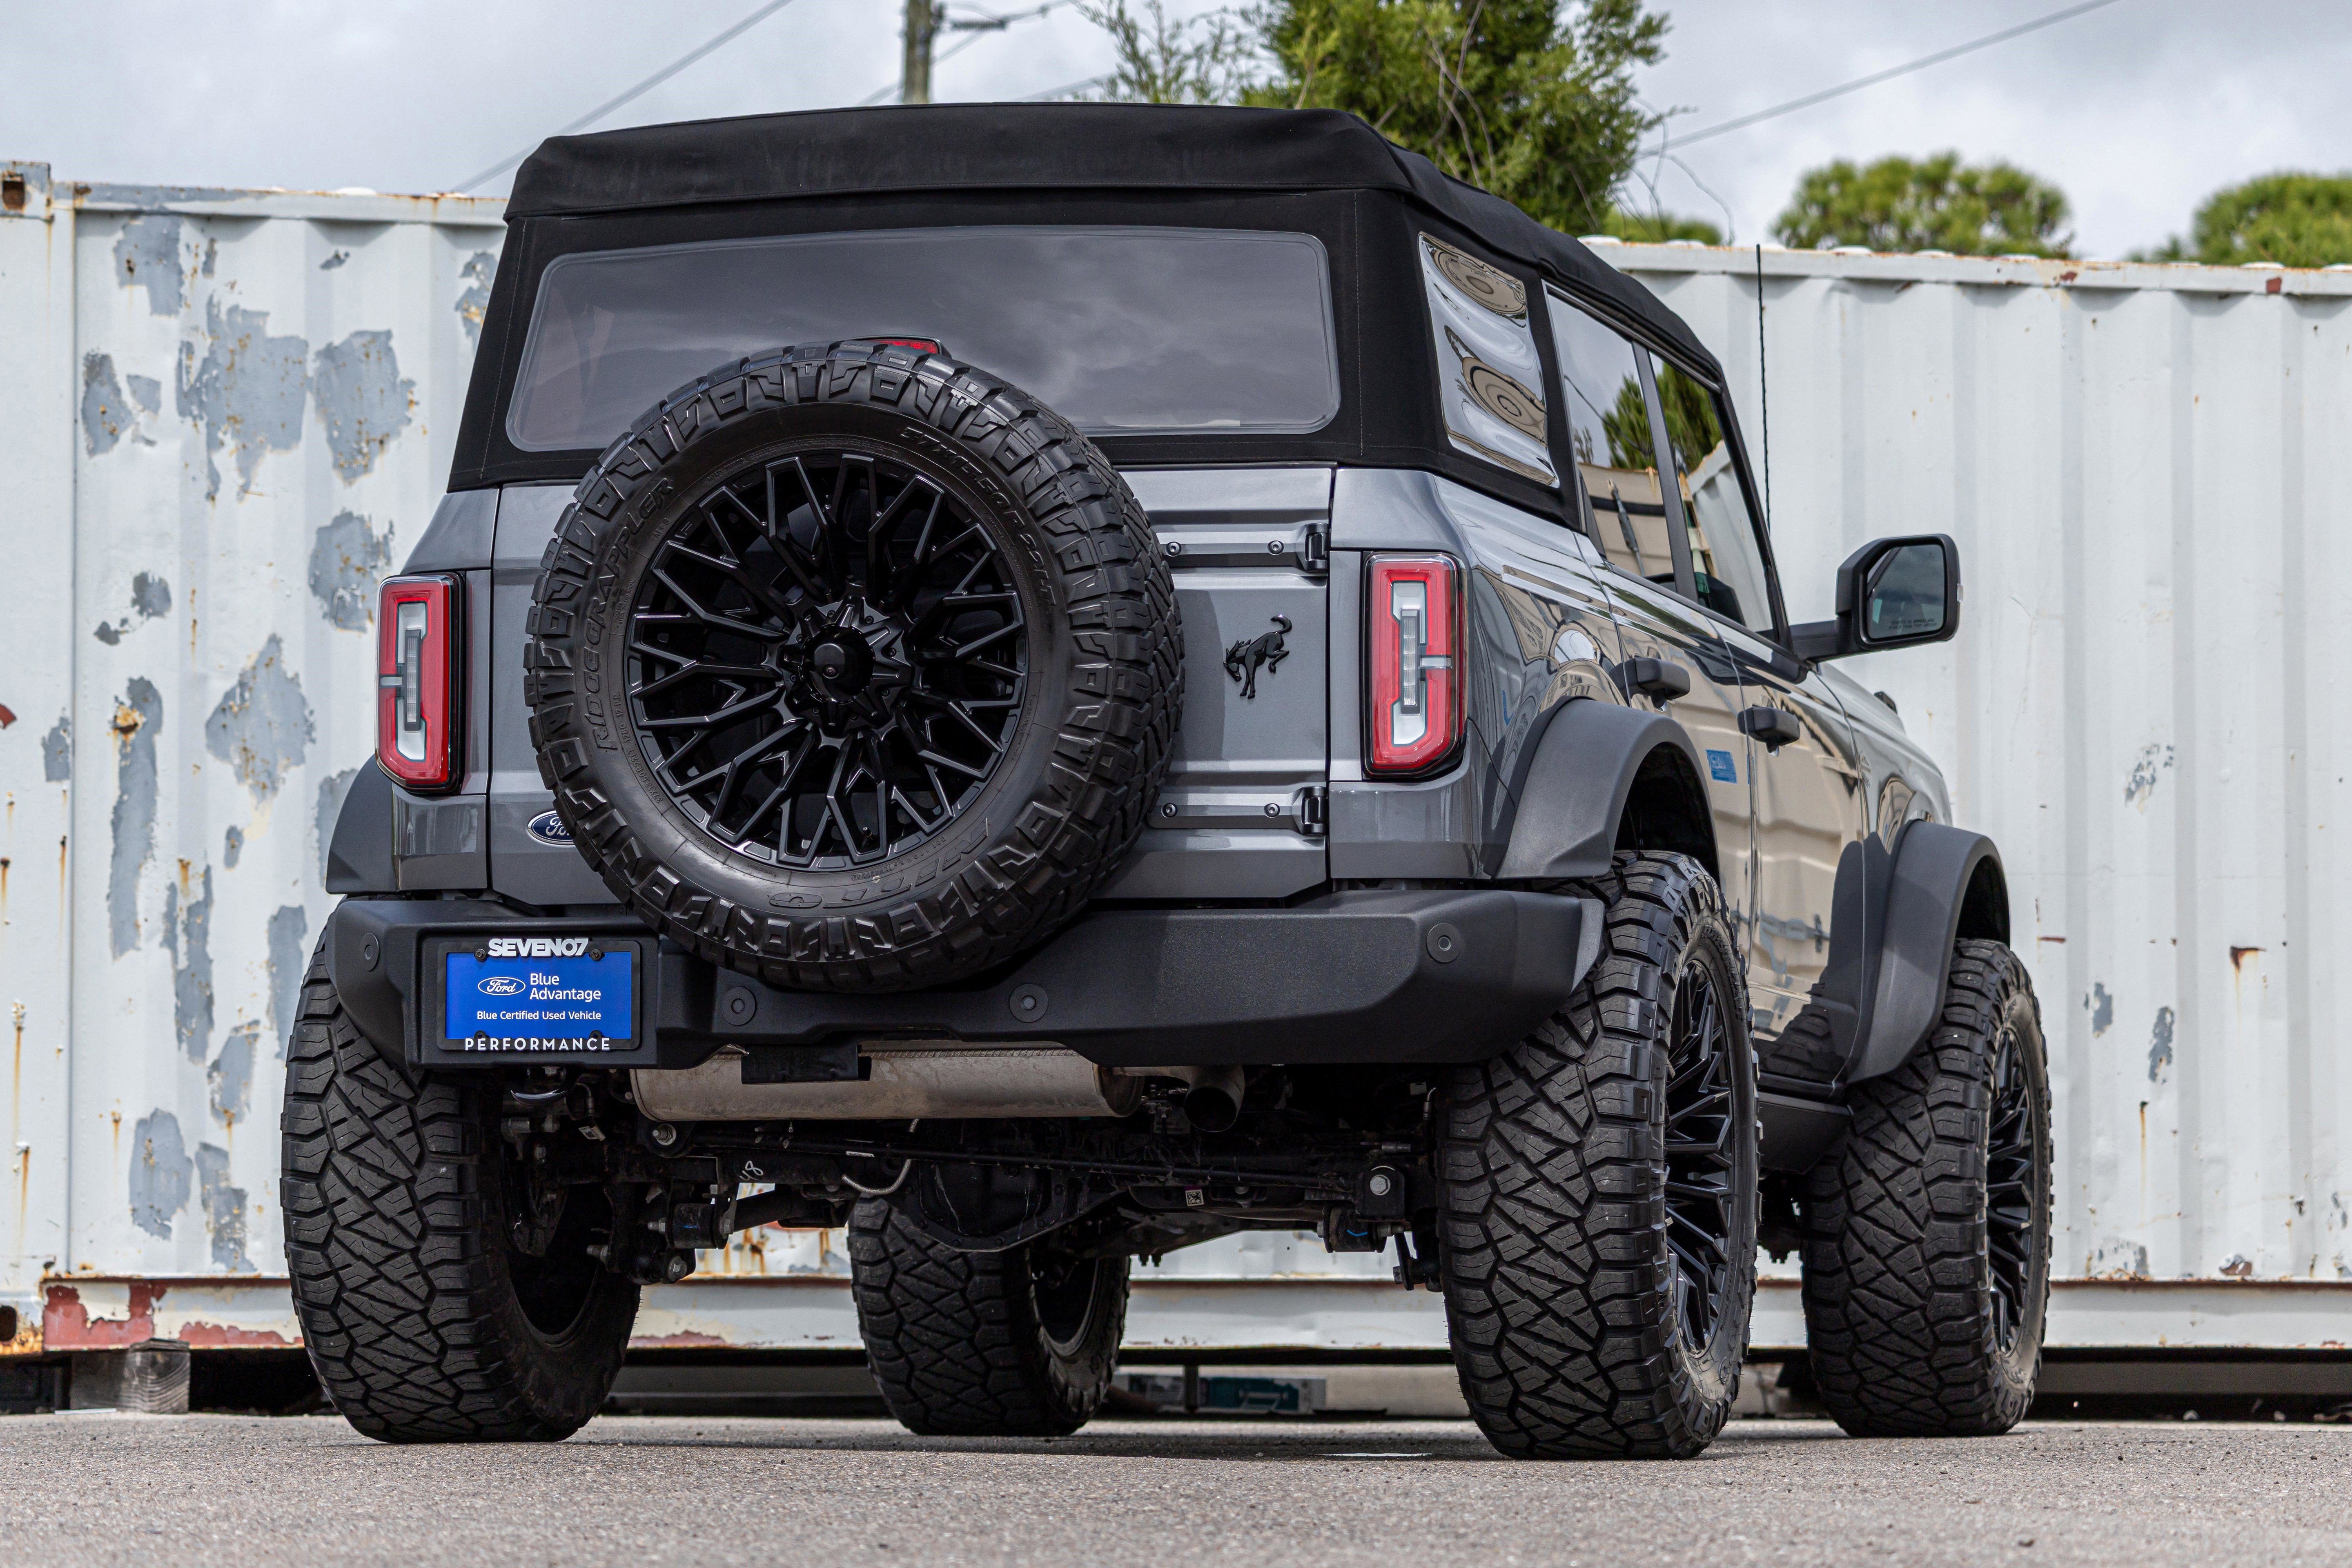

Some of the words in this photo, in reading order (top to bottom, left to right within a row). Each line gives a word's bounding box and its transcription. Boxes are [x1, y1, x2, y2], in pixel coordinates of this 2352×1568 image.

[586, 477, 674, 646] GRAPPLER
[584, 647, 617, 750] RIDGE
[486, 979, 516, 993] Ford
[530, 973, 559, 985] Blue
[530, 987, 601, 1002] Advantage
[477, 1011, 497, 1020] Blue
[500, 1011, 539, 1020] Certified
[542, 1011, 565, 1020] Used
[568, 1011, 601, 1020] Vehicle
[465, 1038, 610, 1051] PERFORMANCE
